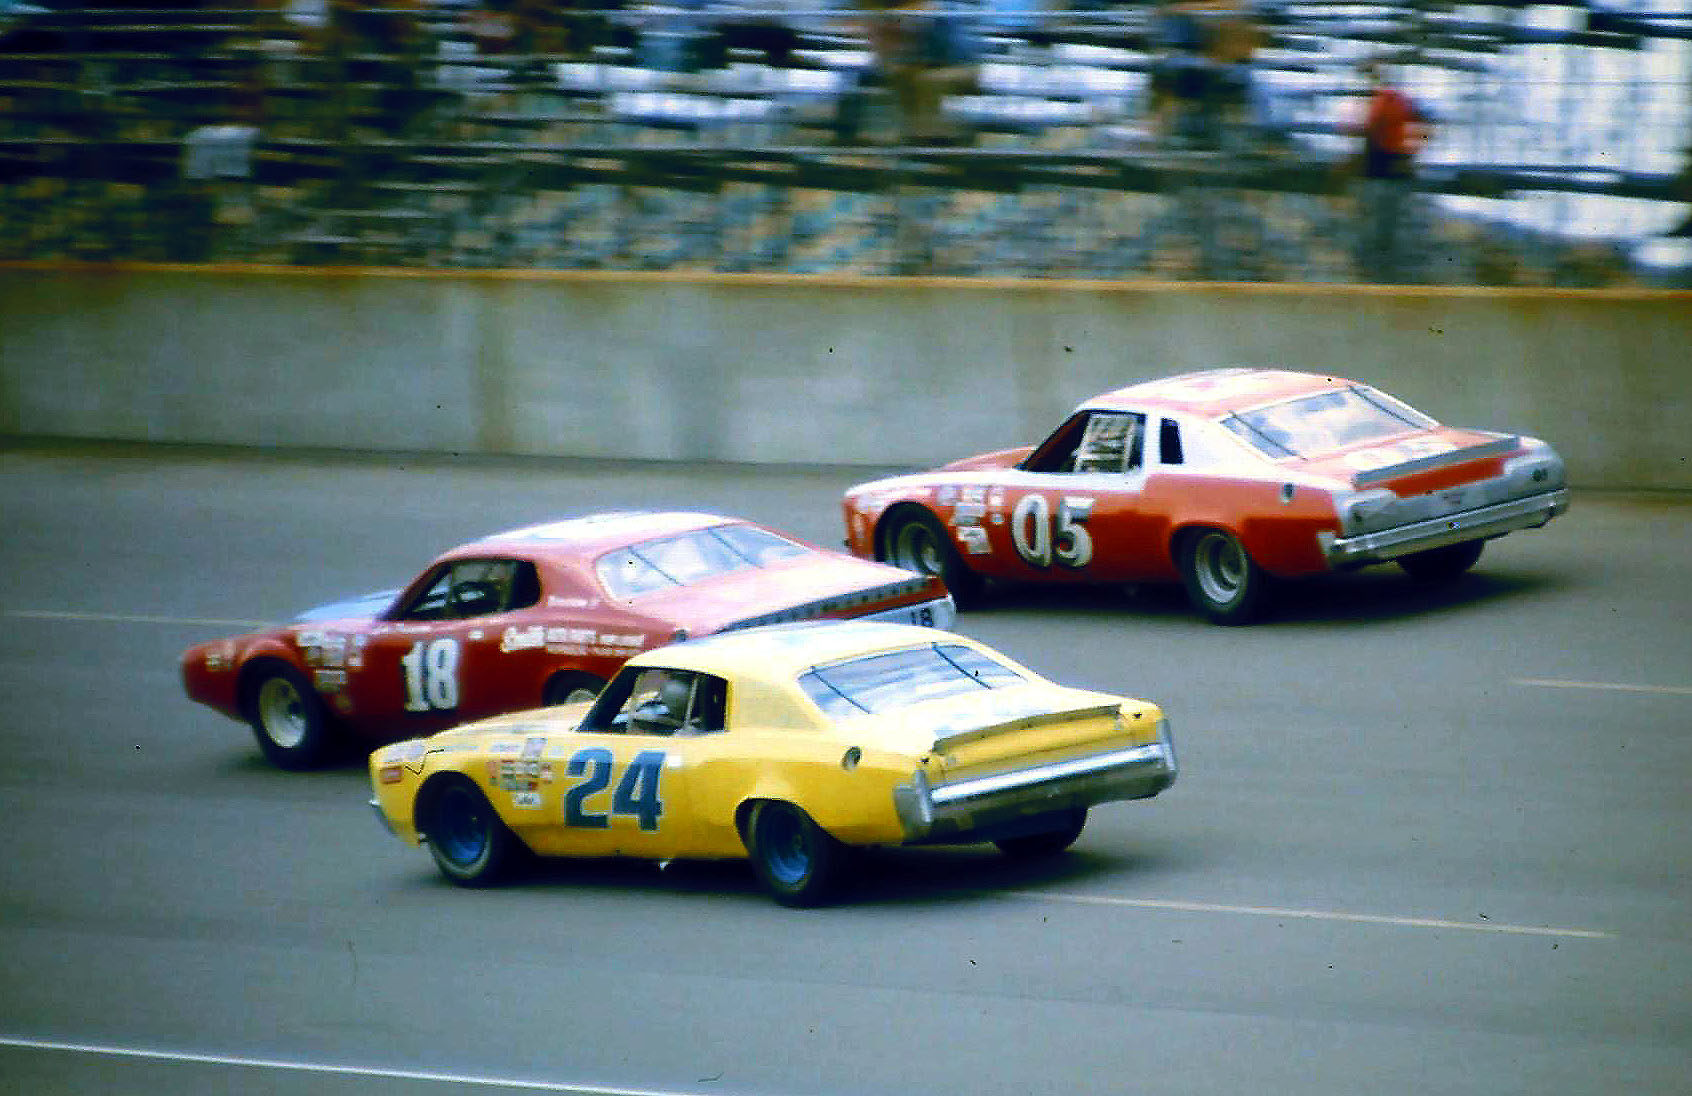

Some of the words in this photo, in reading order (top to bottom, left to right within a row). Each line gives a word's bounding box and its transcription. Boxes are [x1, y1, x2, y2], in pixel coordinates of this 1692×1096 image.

[1012, 493, 1095, 568] 05
[910, 607, 933, 627] 18
[402, 638, 460, 712] 18
[564, 745, 667, 834] 24
